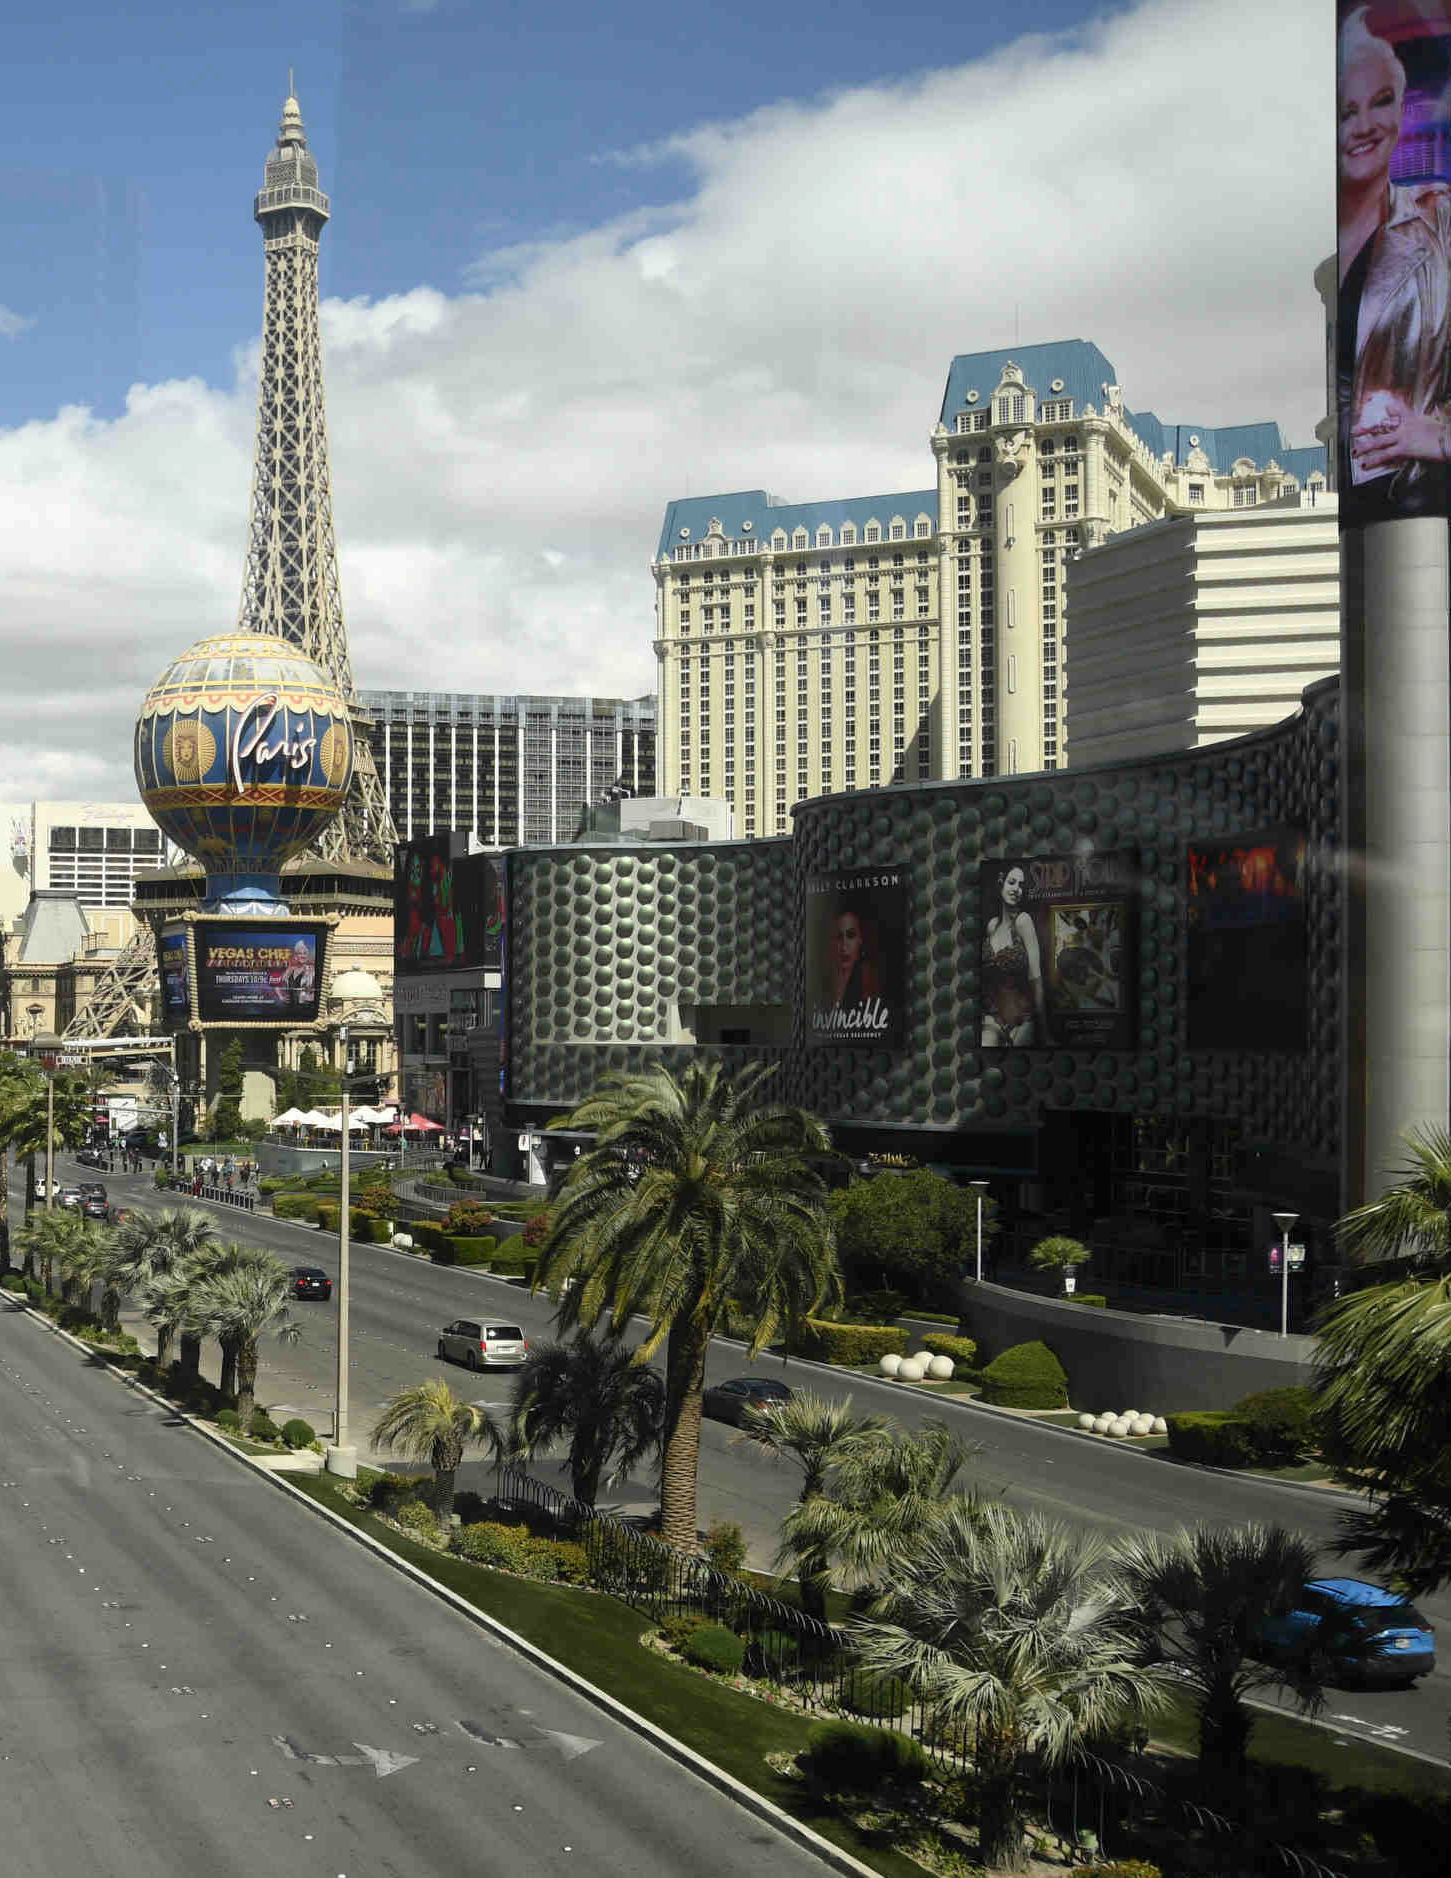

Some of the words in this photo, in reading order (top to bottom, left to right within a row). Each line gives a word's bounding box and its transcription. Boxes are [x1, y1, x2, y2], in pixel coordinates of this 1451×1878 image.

[233, 692, 317, 793] Paris
[836, 875, 899, 890] CLARKSON
[208, 947, 254, 960] VEGAS
[258, 947, 291, 960] CHEF
[216, 975, 249, 984] THURSDAYS
[813, 996, 889, 1029] invincible
